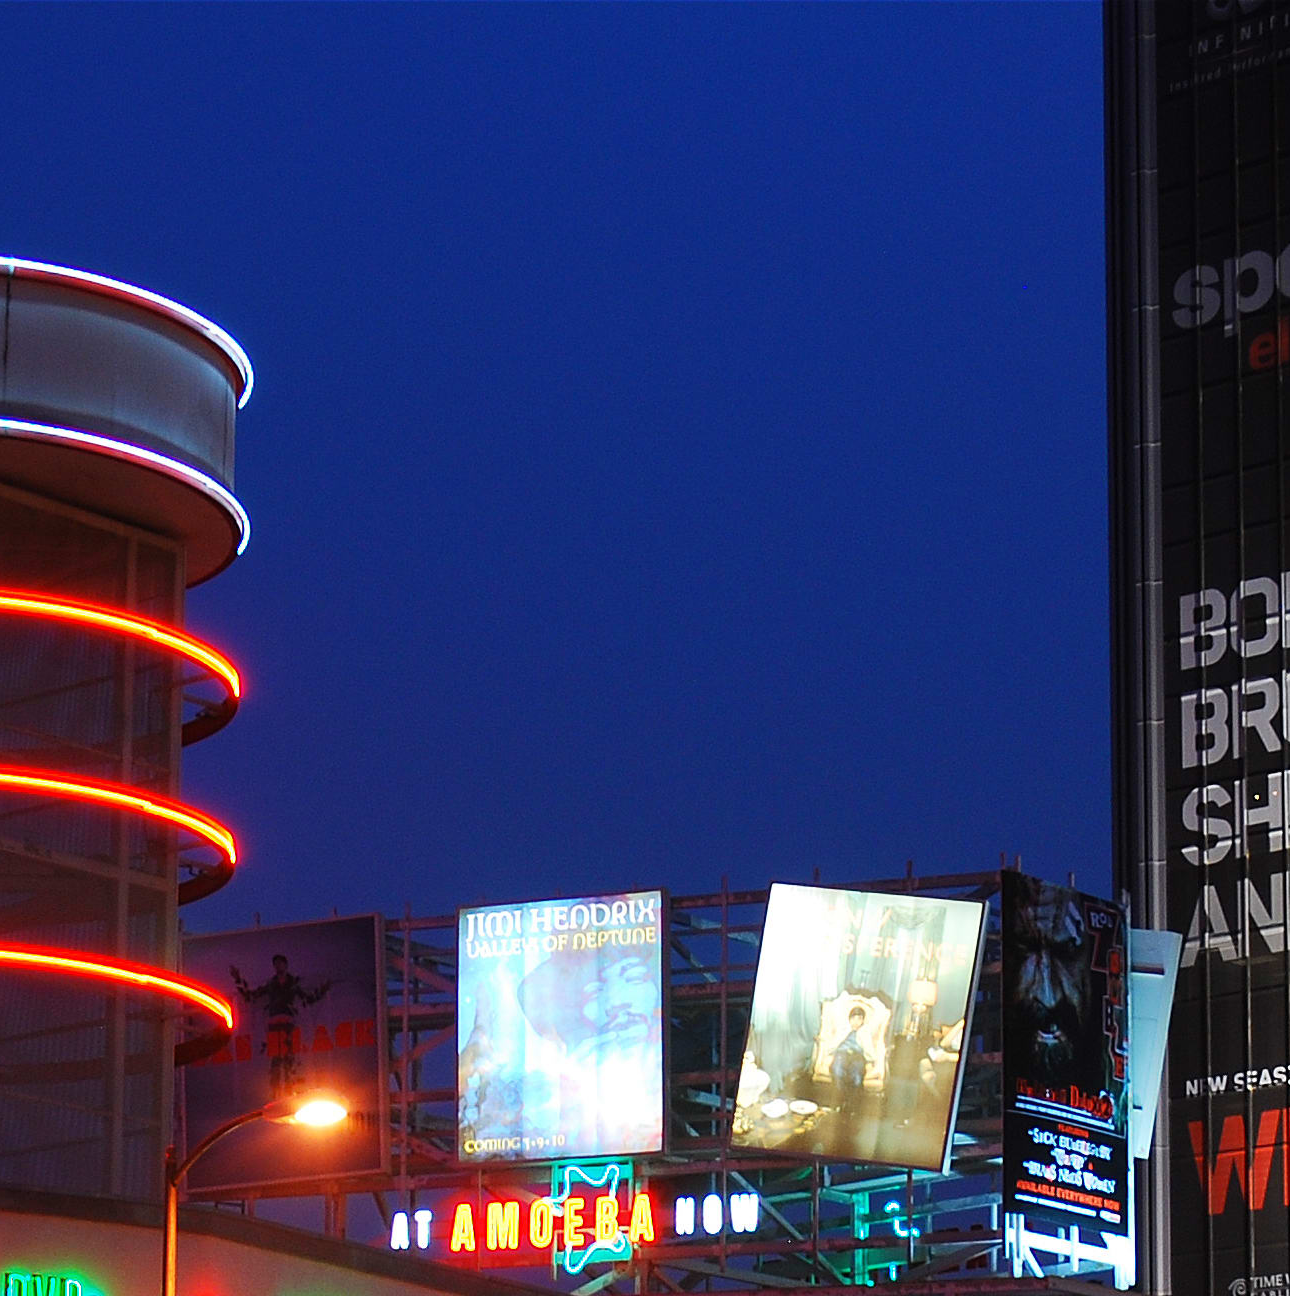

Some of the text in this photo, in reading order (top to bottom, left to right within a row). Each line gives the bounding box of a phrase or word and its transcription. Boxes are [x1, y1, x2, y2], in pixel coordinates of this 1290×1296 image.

[465, 898, 657, 943] JIMI HENDRIX
[542, 932, 569, 953] OF
[571, 925, 658, 951] NEPTUNE
[1185, 1074, 1228, 1099] NEW
[390, 1193, 760, 1252] AT AMOEBA NOW
[1250, 1273, 1284, 1290] TIME
